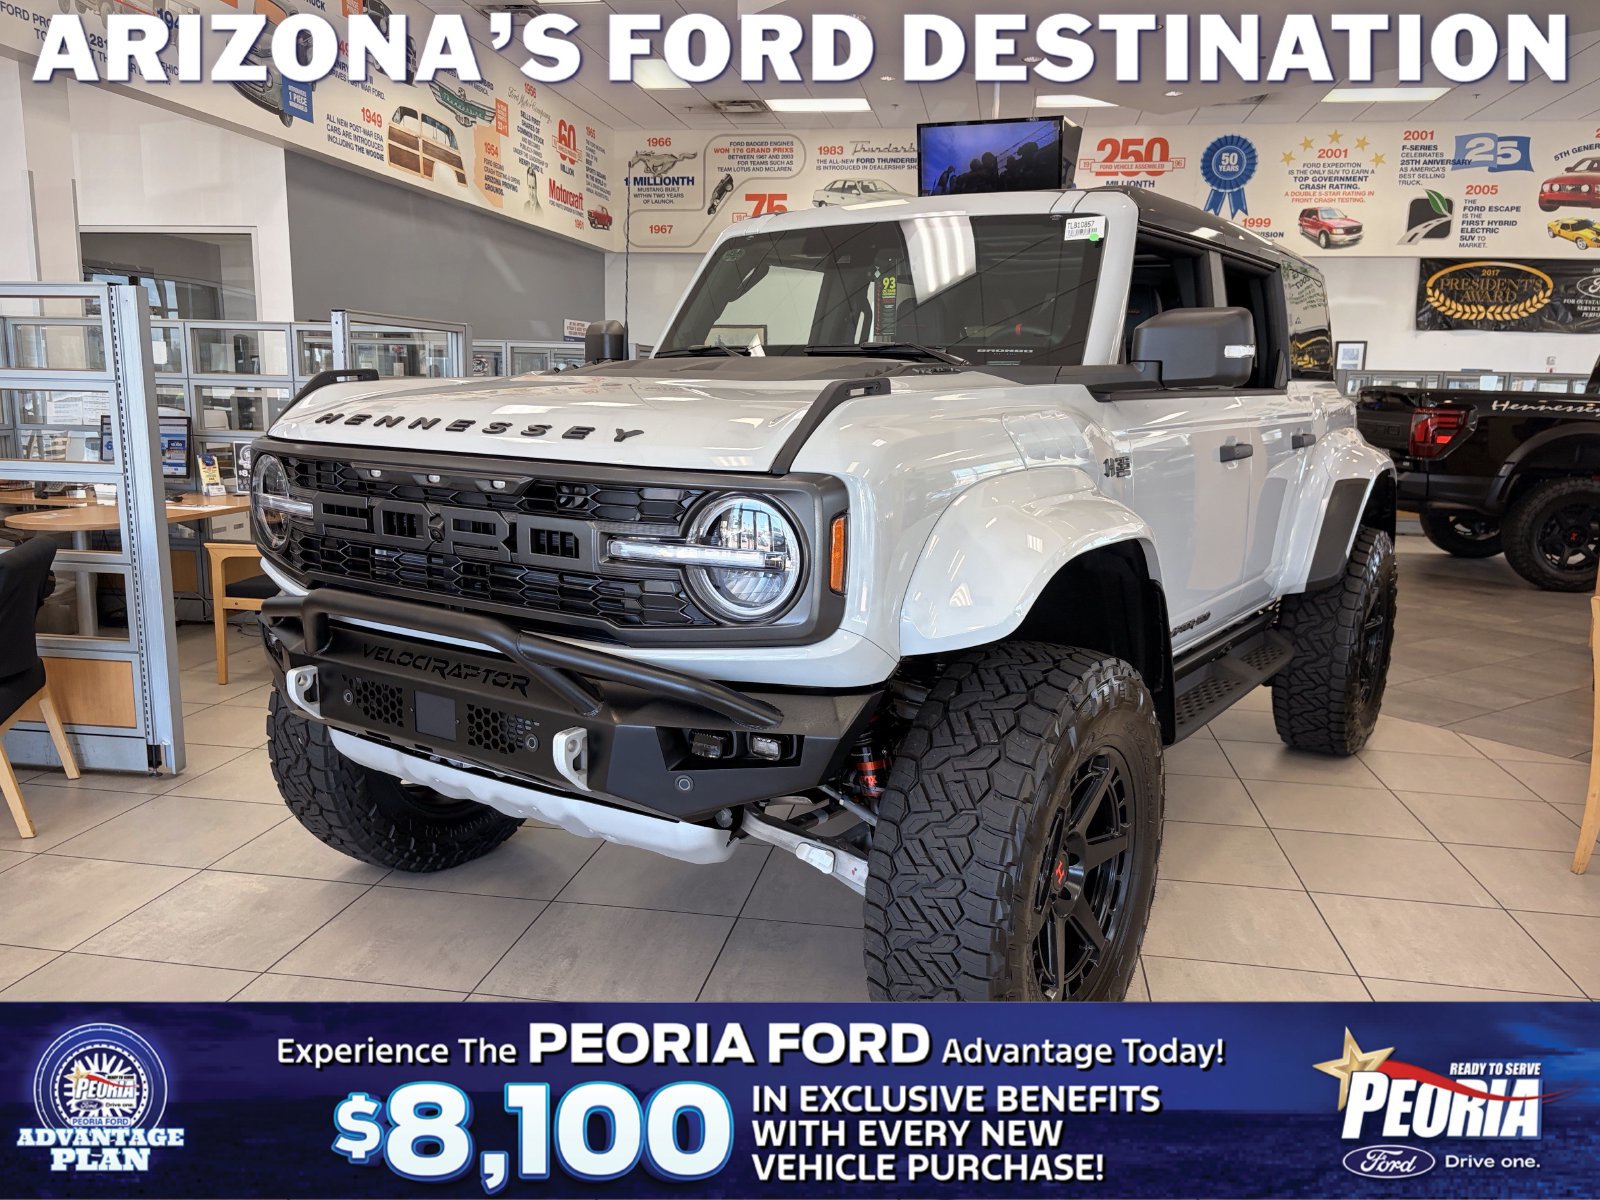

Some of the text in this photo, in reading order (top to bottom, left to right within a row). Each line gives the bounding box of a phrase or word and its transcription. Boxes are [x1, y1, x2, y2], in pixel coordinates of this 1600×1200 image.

[0, 3, 30, 21] FORD
[361, 107, 383, 128] 1949
[326, 113, 384, 142] ALL NEW POST-WAR ERA
[326, 124, 384, 152] CARS ARE INTRODUCED
[558, 118, 576, 166] 60
[646, 137, 672, 147] 1966
[1403, 130, 1435, 141] 2001
[326, 134, 355, 152] INCLUDING
[354, 143, 366, 155] THE
[484, 141, 498, 158] 1954
[817, 146, 844, 155] 1983
[1464, 136, 1522, 166] 25
[1095, 137, 1170, 177] 250
[1221, 152, 1239, 165] 50
[1317, 148, 1349, 159] 2001
[1554, 149, 1570, 162] 5TH
[1218, 164, 1239, 172] YEARS
[633, 176, 695, 186] MILLIONTH
[548, 177, 584, 211] Motorcraft
[1465, 185, 1498, 195] 2005
[648, 224, 674, 234] 1967
[1242, 218, 1271, 228] 1999
[1481, 269, 1500, 277] 2017
[882, 276, 896, 290] 93
[1460, 289, 1518, 303] AWARD
[314, 412, 645, 442] HENNESSEY
[311, 488, 601, 572] FORD
[361, 643, 531, 698] VELOCIRAPTOR
